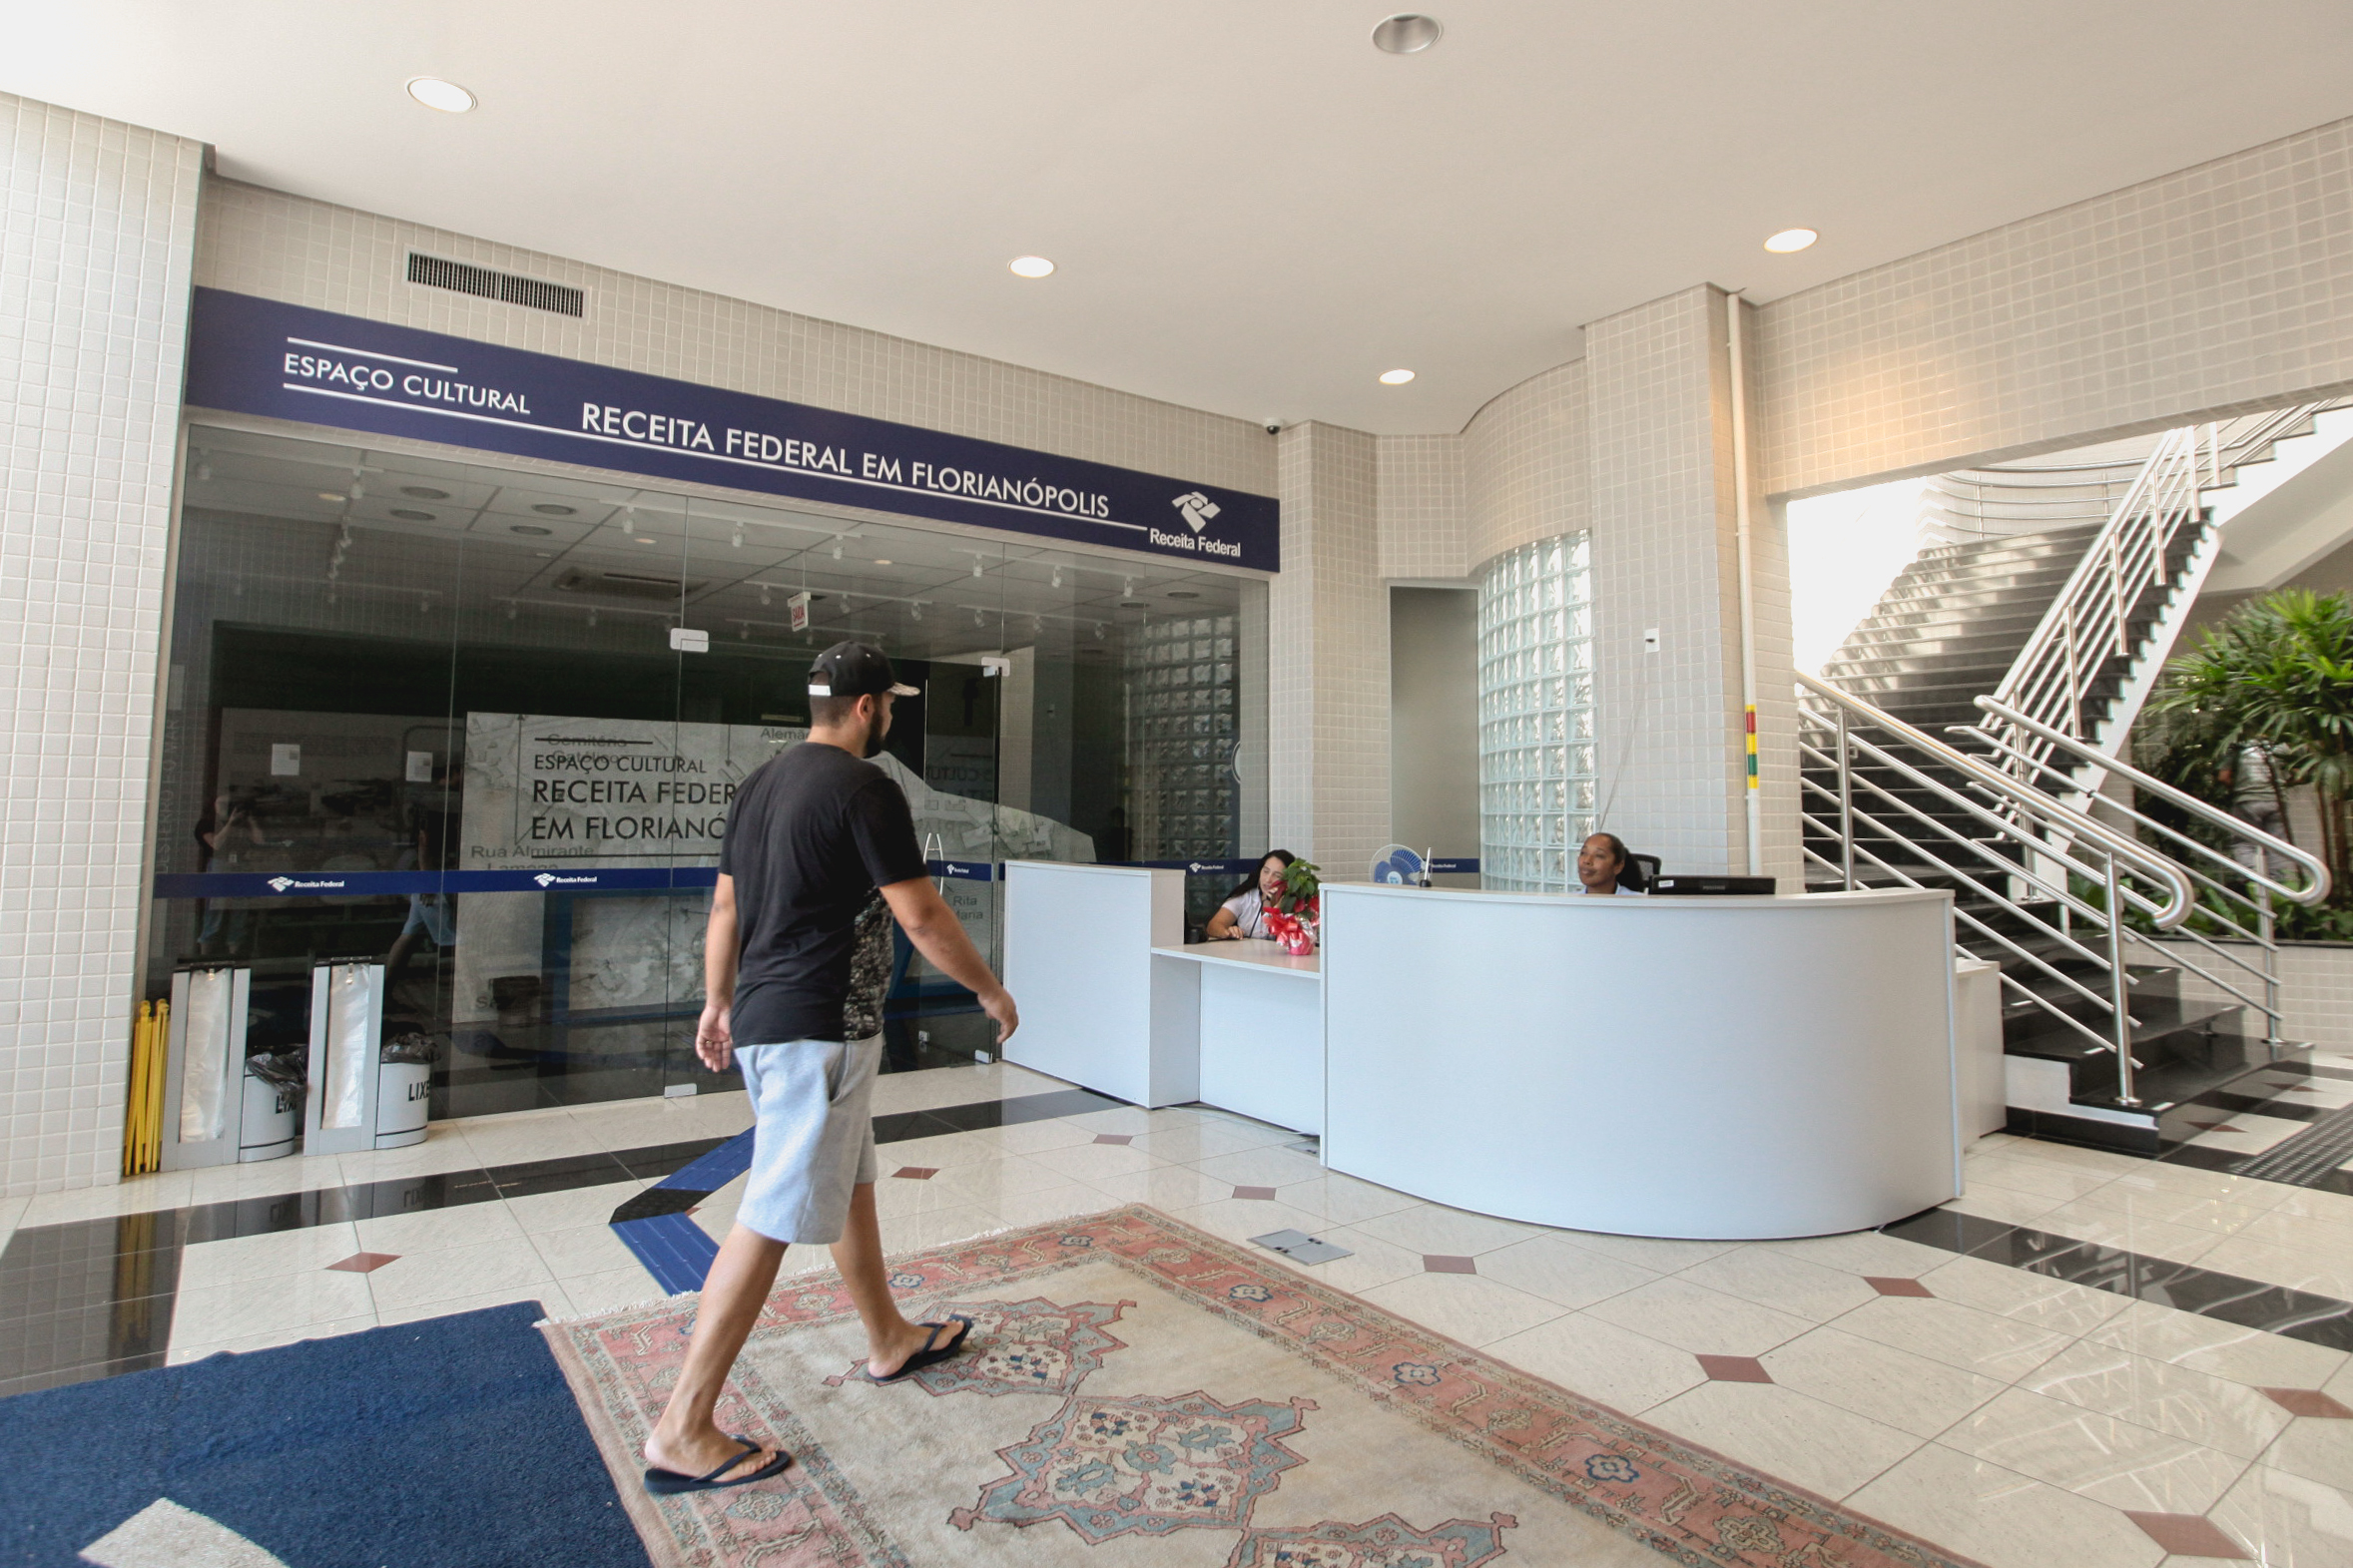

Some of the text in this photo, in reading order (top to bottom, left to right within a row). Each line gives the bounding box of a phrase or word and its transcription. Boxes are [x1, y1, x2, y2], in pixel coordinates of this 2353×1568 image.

[284, 351, 531, 415] ESPAÇO CULTURAL
[581, 401, 1110, 519] RECEITA FEDERAL EM FLORIANÓPOLIS
[1149, 527, 1241, 557] Receita Federal
[534, 755, 707, 775] ESPAÇO CULTURAL
[533, 780, 736, 805] RECEITA FEDER
[531, 811, 727, 839] EM FLORIANÓ
[470, 844, 595, 858] Rua Almirante
